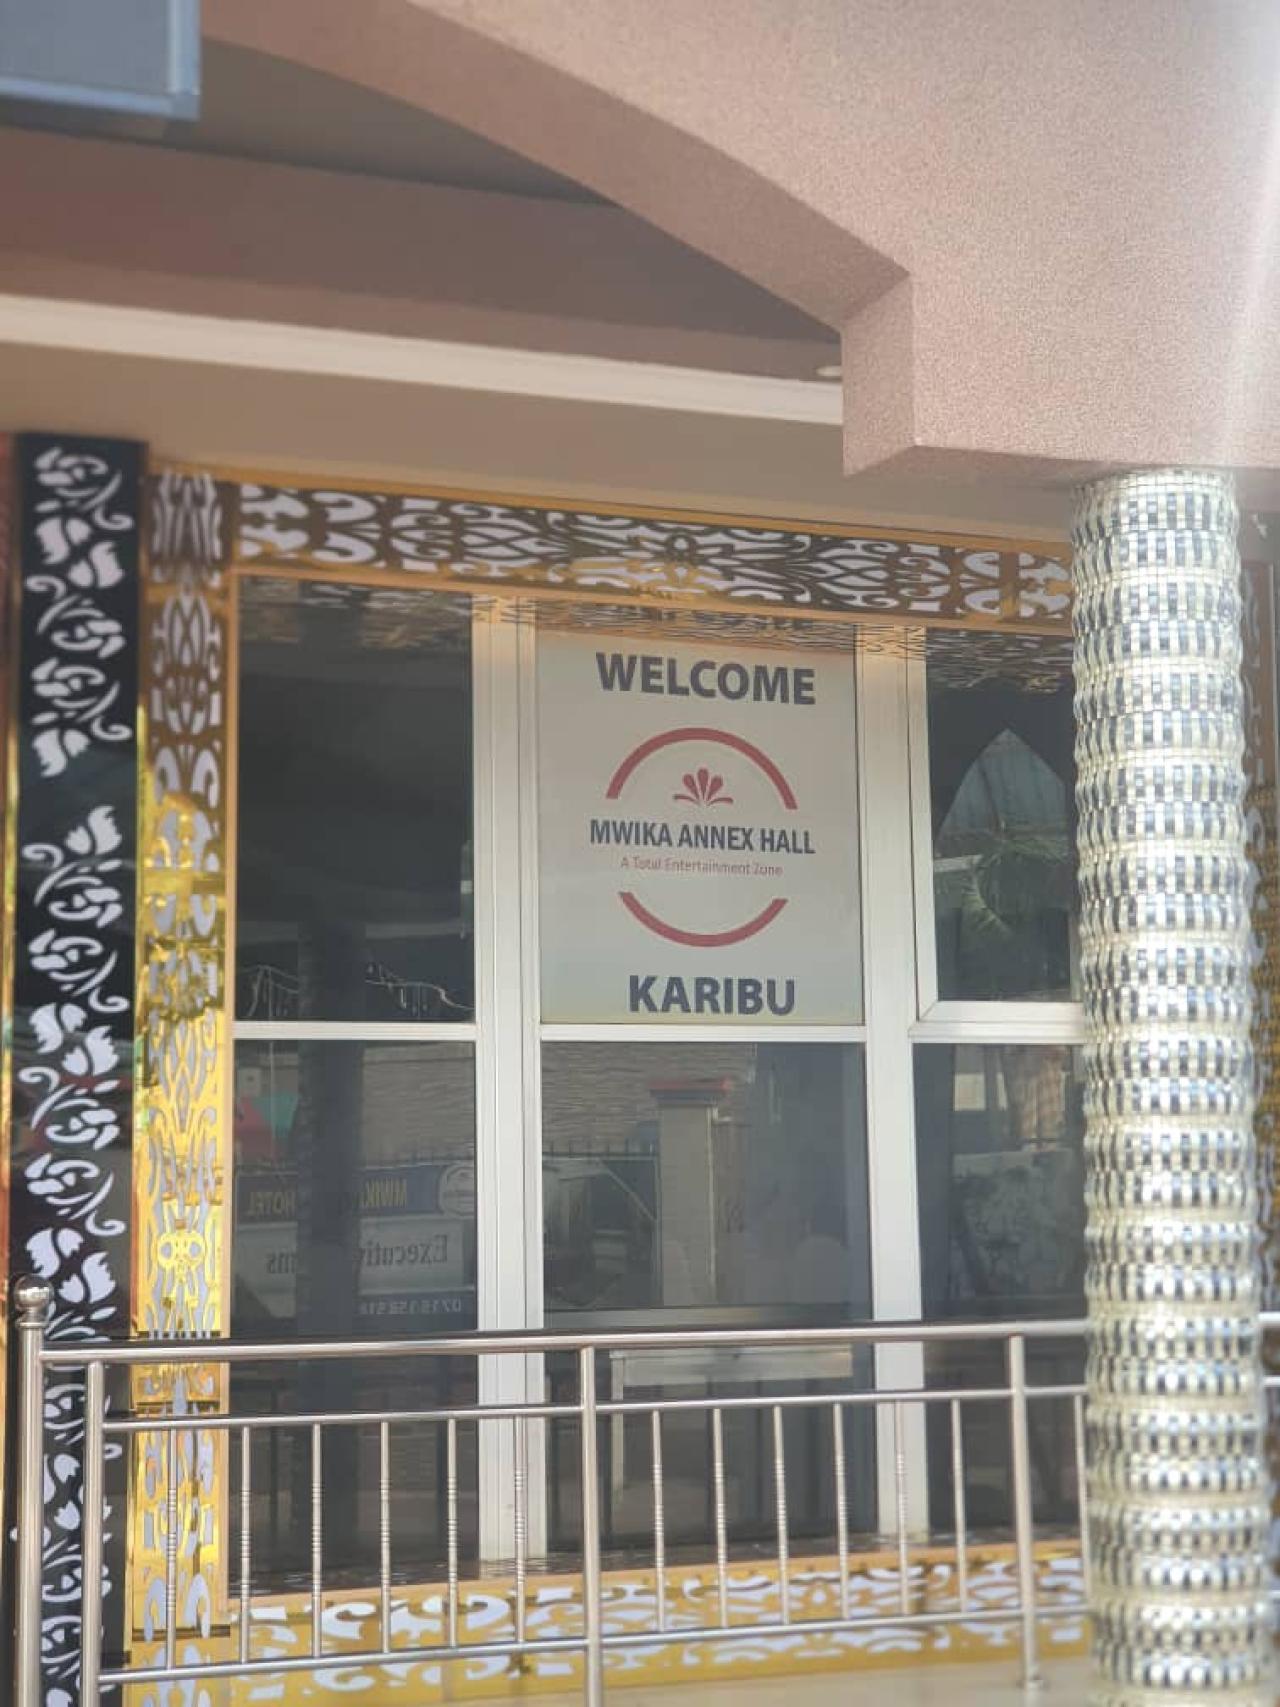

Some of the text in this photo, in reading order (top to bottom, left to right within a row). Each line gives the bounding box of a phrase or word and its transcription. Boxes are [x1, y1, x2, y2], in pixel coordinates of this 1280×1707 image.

[596, 652, 816, 705] WELCOME
[590, 819, 816, 854] MWIKA ANNEX HALL
[633, 856, 661, 870] Total
[664, 858, 750, 876] Entertainment
[753, 862, 784, 876] Zone
[629, 975, 796, 1016] KARIBU
